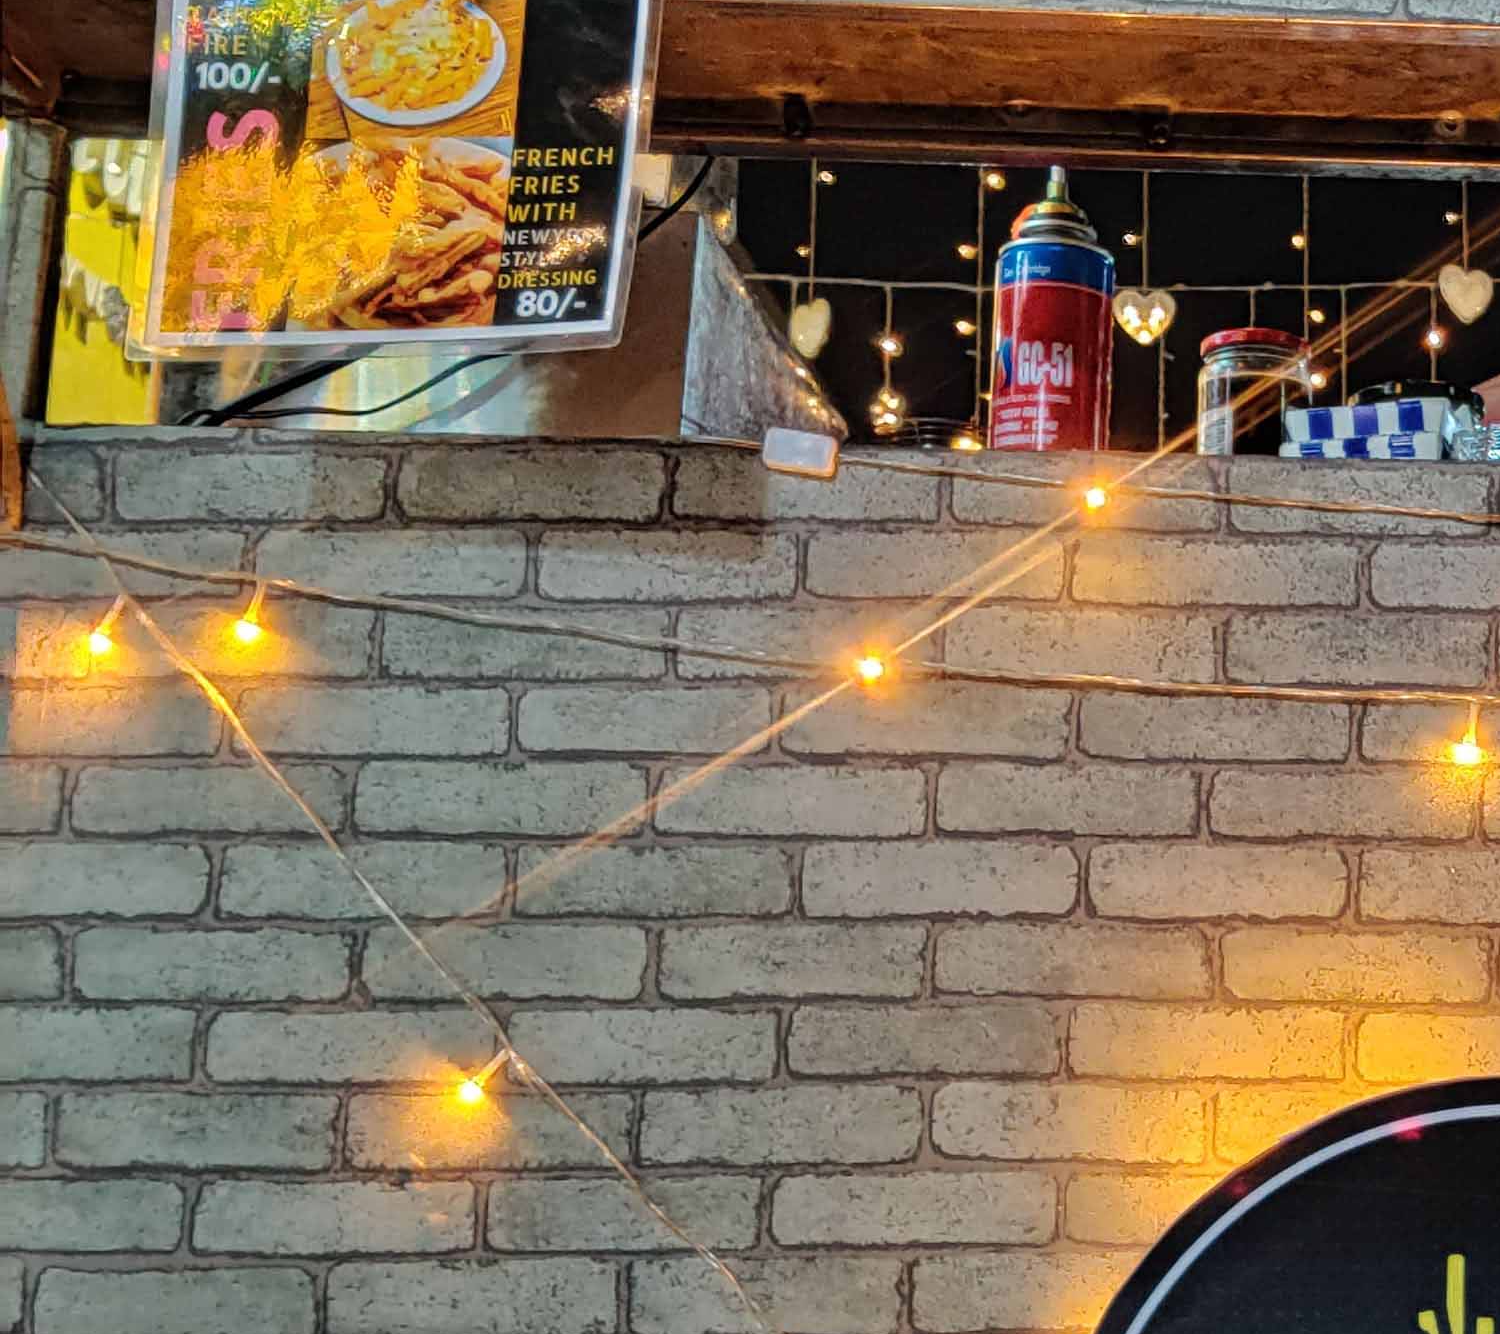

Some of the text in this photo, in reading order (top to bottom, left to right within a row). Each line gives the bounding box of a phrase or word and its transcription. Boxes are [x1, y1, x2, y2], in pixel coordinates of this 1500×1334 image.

[195, 61, 282, 94] 100/-
[511, 146, 615, 168] FRENCH
[509, 174, 581, 196] FRIES
[507, 201, 577, 223] WITH
[498, 268, 598, 290] DRESSING
[515, 287, 588, 319] 80/-
[1017, 339, 1074, 388] GC-51
